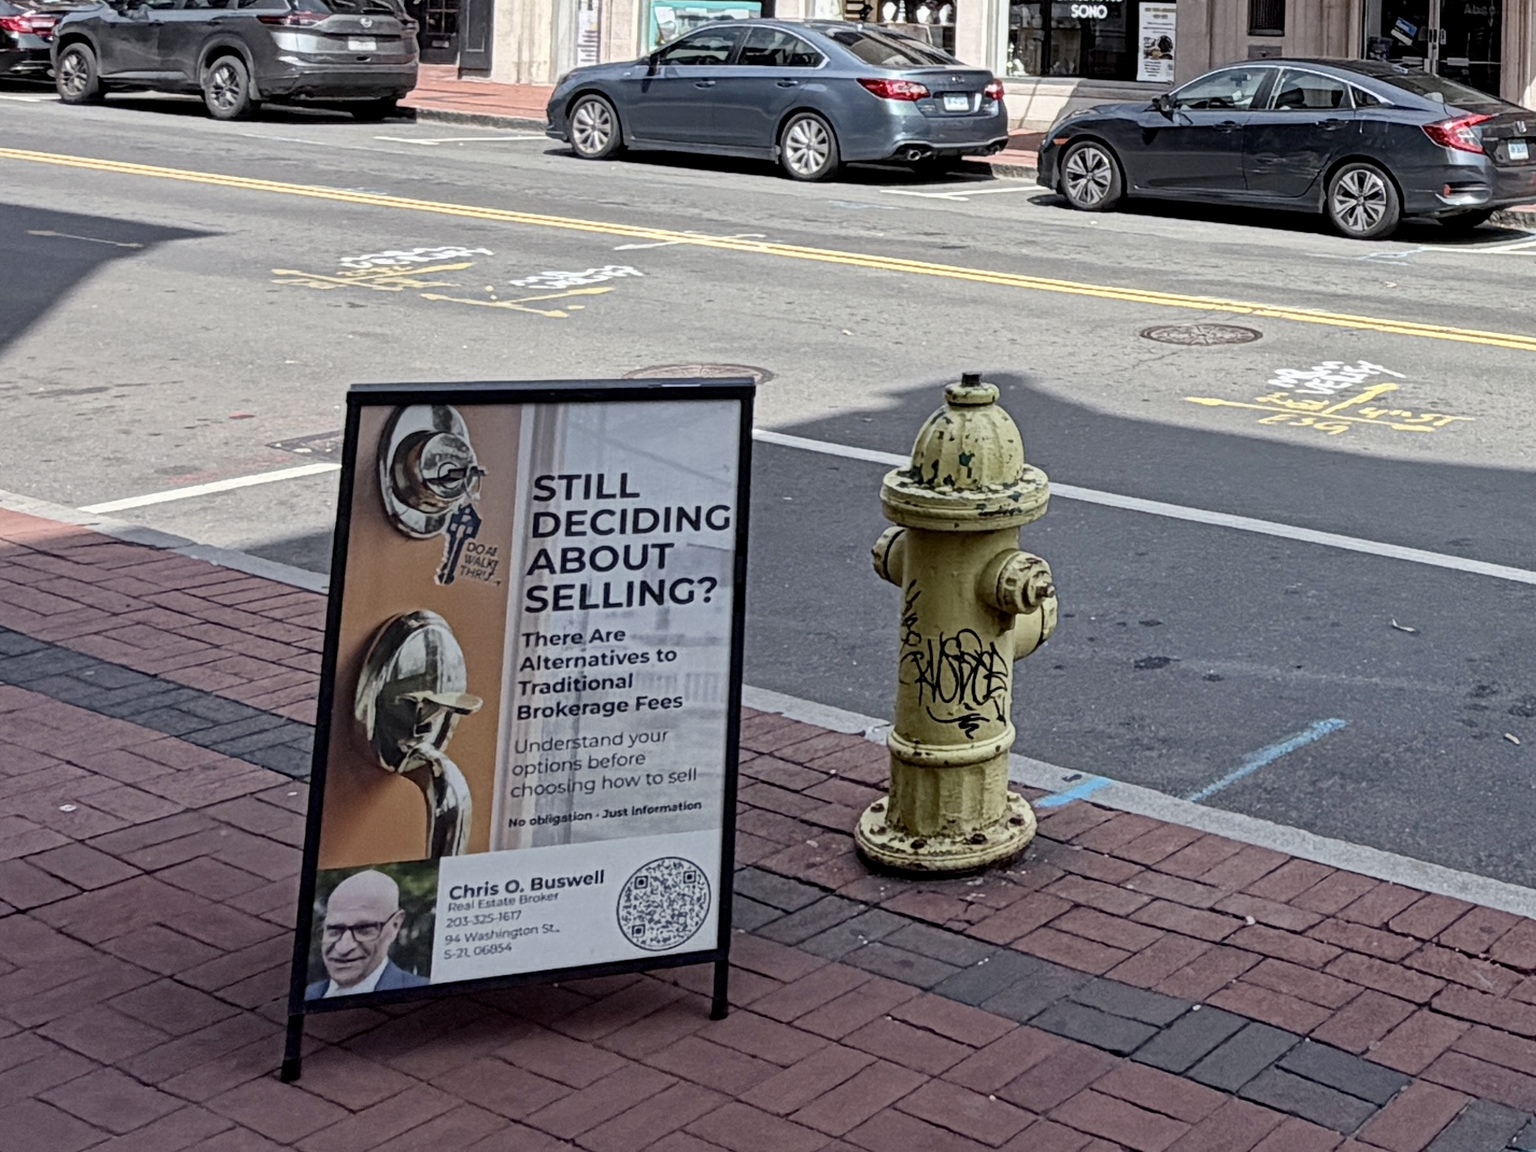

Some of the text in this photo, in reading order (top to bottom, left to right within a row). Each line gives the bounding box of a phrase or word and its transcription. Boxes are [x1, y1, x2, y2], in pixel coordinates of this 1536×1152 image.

[1071, 4, 1108, 19] SONO
[532, 472, 640, 502] STILL
[532, 504, 731, 539] DECIDING
[526, 542, 675, 576] ABOUT
[524, 576, 718, 614] SELLING?
[522, 628, 626, 648] There Are
[519, 648, 677, 672] Alternatives to
[518, 673, 633, 696] Traditional
[516, 695, 683, 720] Brokerage Fees
[515, 730, 669, 754] Understand your
[512, 753, 646, 778] options before
[510, 767, 697, 799] choosing how to sell
[508, 818, 526, 828] No
[529, 811, 593, 827] obligation
[602, 808, 628, 819] Just
[449, 869, 605, 901] Chris O. Buswell
[448, 892, 559, 912] Real Estate Broker
[444, 934, 461, 946] 94
[464, 925, 539, 944] Washington
